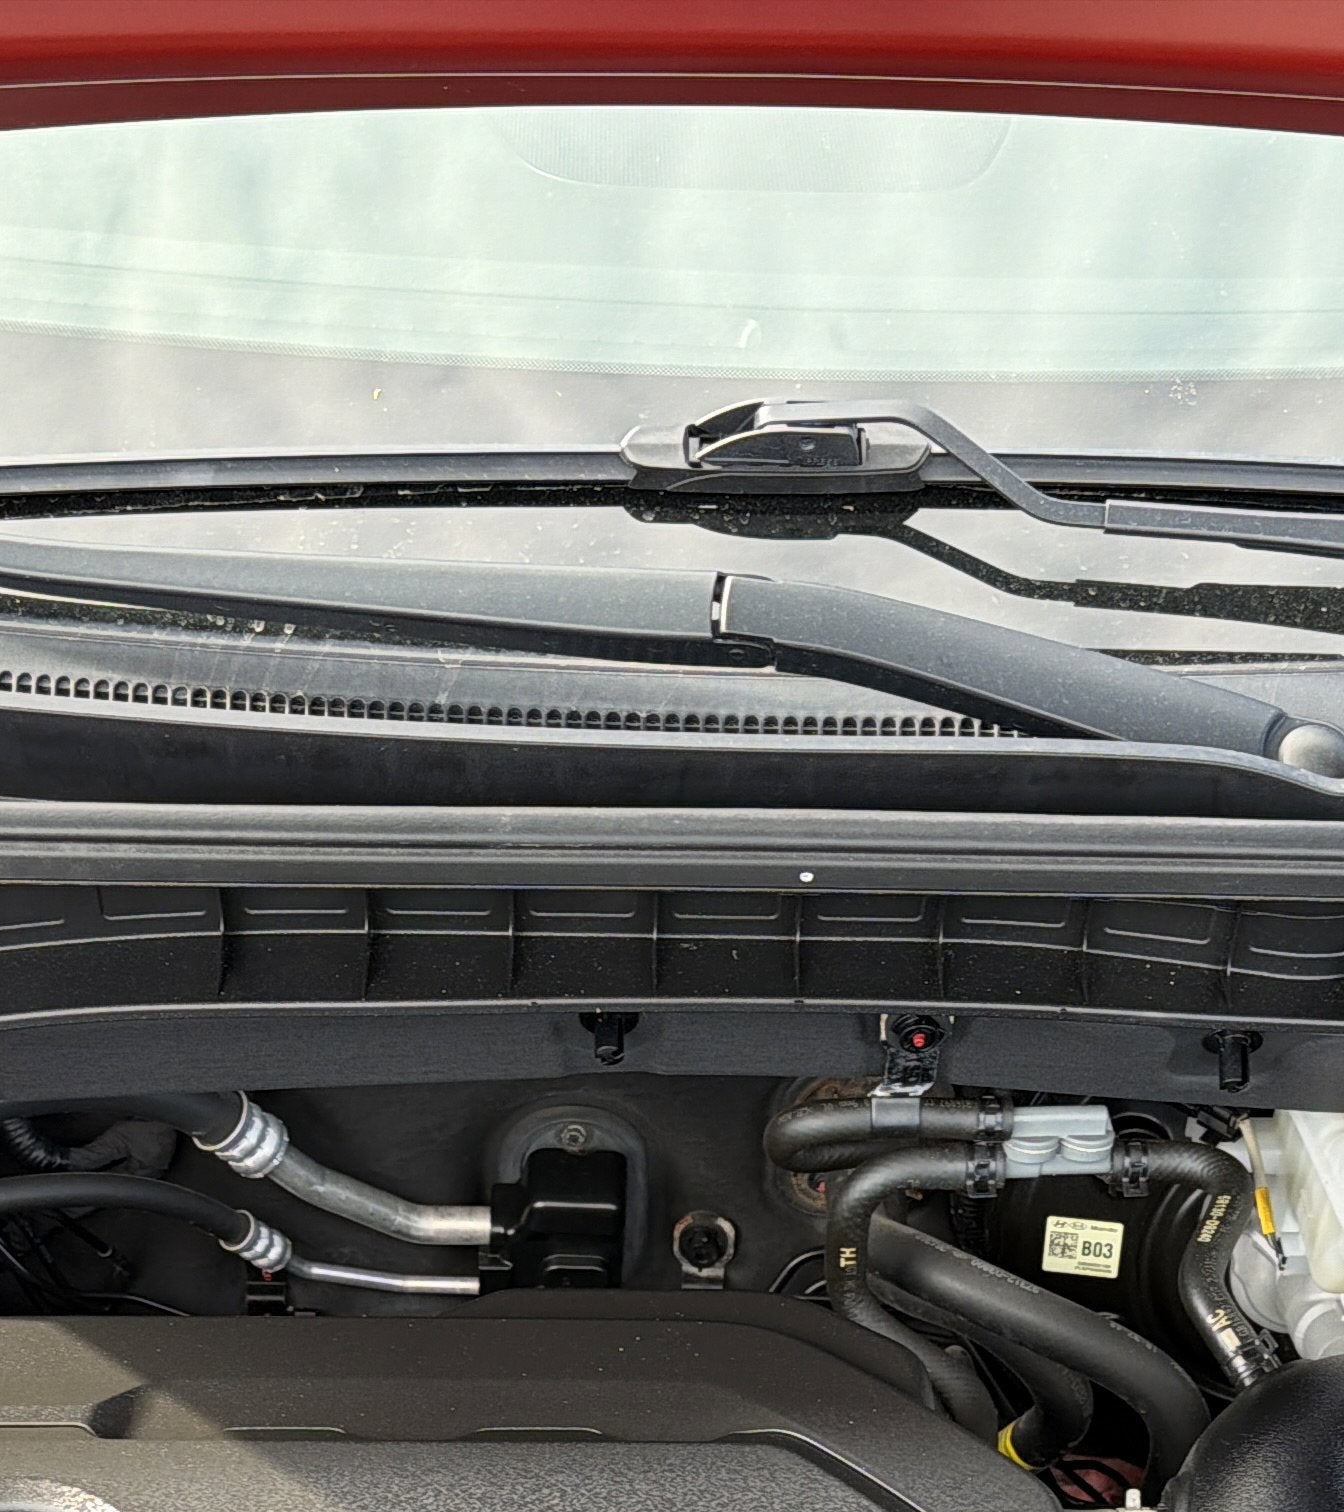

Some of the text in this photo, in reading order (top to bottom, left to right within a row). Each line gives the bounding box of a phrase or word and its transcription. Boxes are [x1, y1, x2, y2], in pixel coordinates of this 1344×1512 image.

[840, 1247, 857, 1267] TH
[1081, 1241, 1114, 1259] B03
[1208, 1309, 1232, 1332] AC
